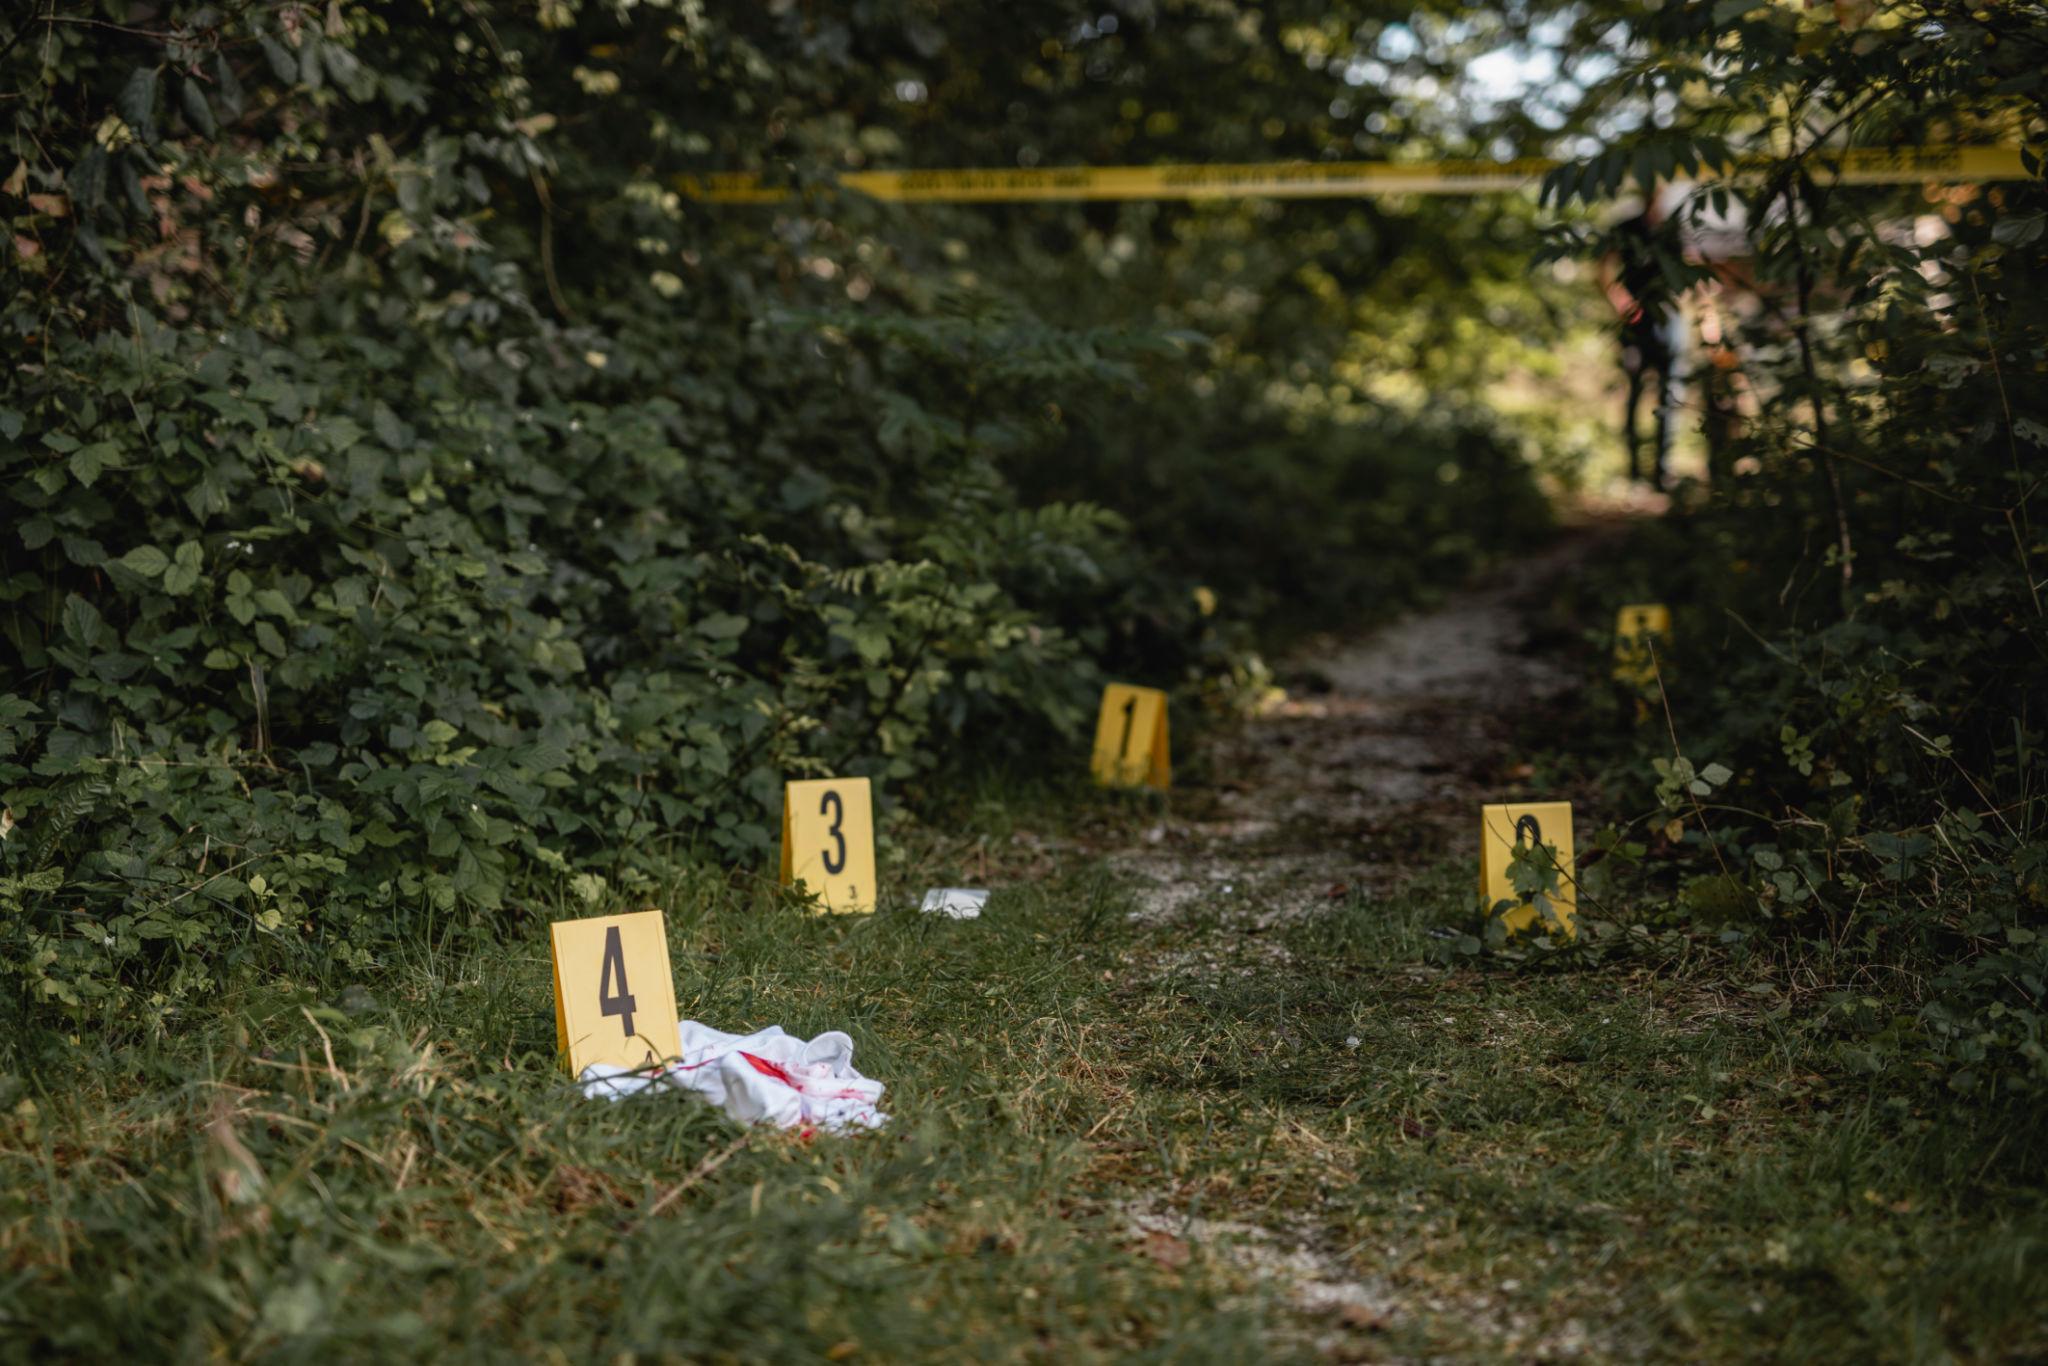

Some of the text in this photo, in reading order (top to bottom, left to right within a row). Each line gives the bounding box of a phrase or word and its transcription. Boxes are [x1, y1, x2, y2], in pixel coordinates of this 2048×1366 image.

[1122, 695, 1137, 758] 1
[820, 789, 846, 875] 3
[600, 925, 636, 1037] 4
